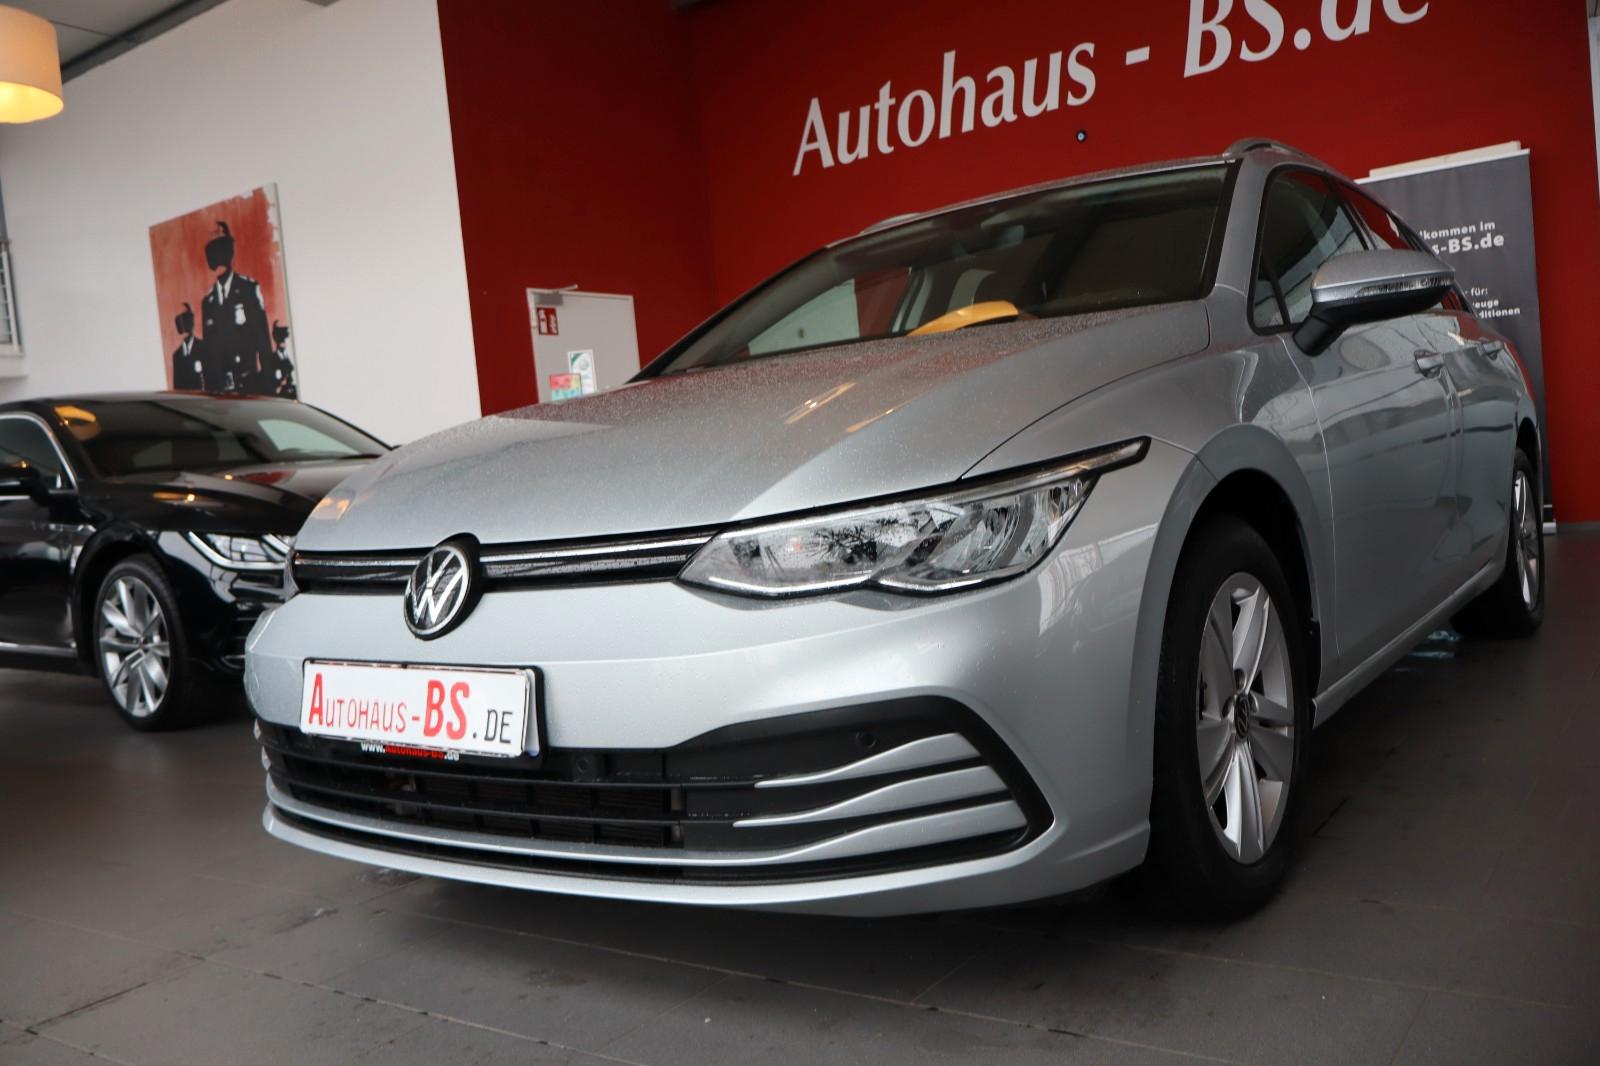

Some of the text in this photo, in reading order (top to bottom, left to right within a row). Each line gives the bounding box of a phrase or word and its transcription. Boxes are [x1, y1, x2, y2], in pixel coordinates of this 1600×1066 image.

[793, 42, 1096, 176] Autohaus
[1480, 221, 1496, 232] im
[1472, 299, 1500, 309] euge
